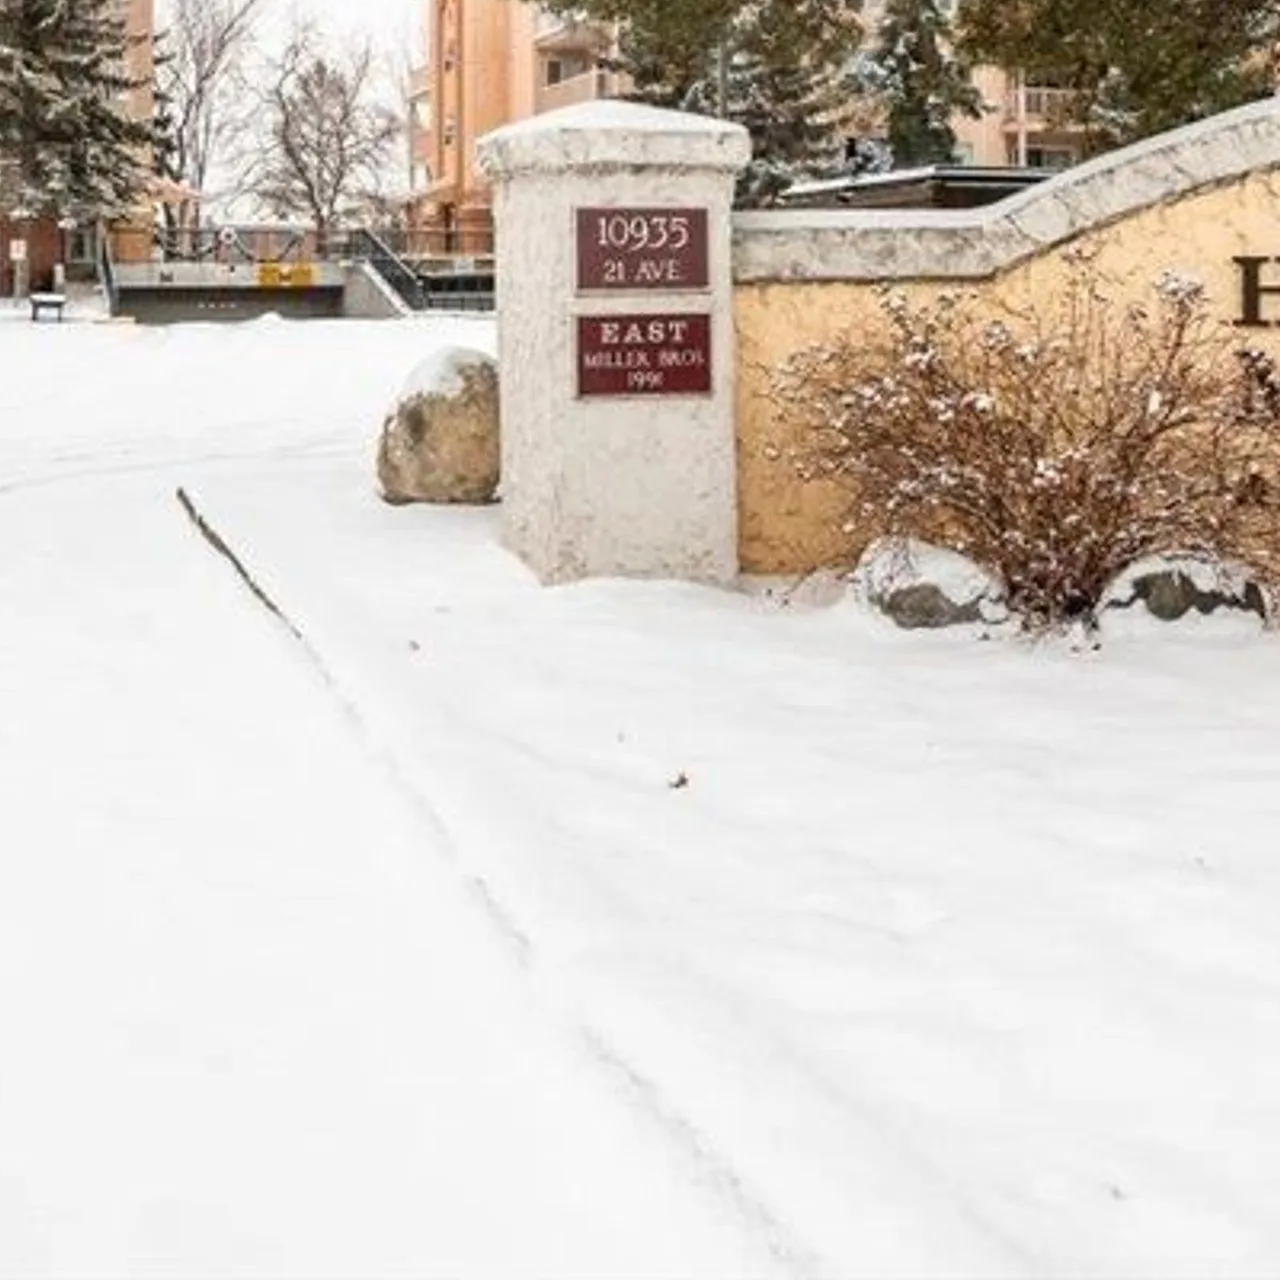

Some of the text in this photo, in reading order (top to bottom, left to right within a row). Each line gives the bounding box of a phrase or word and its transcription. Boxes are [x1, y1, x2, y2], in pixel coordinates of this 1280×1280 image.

[597, 215, 690, 251] 10935
[603, 260, 626, 282] 21
[600, 321, 688, 344] EAST
